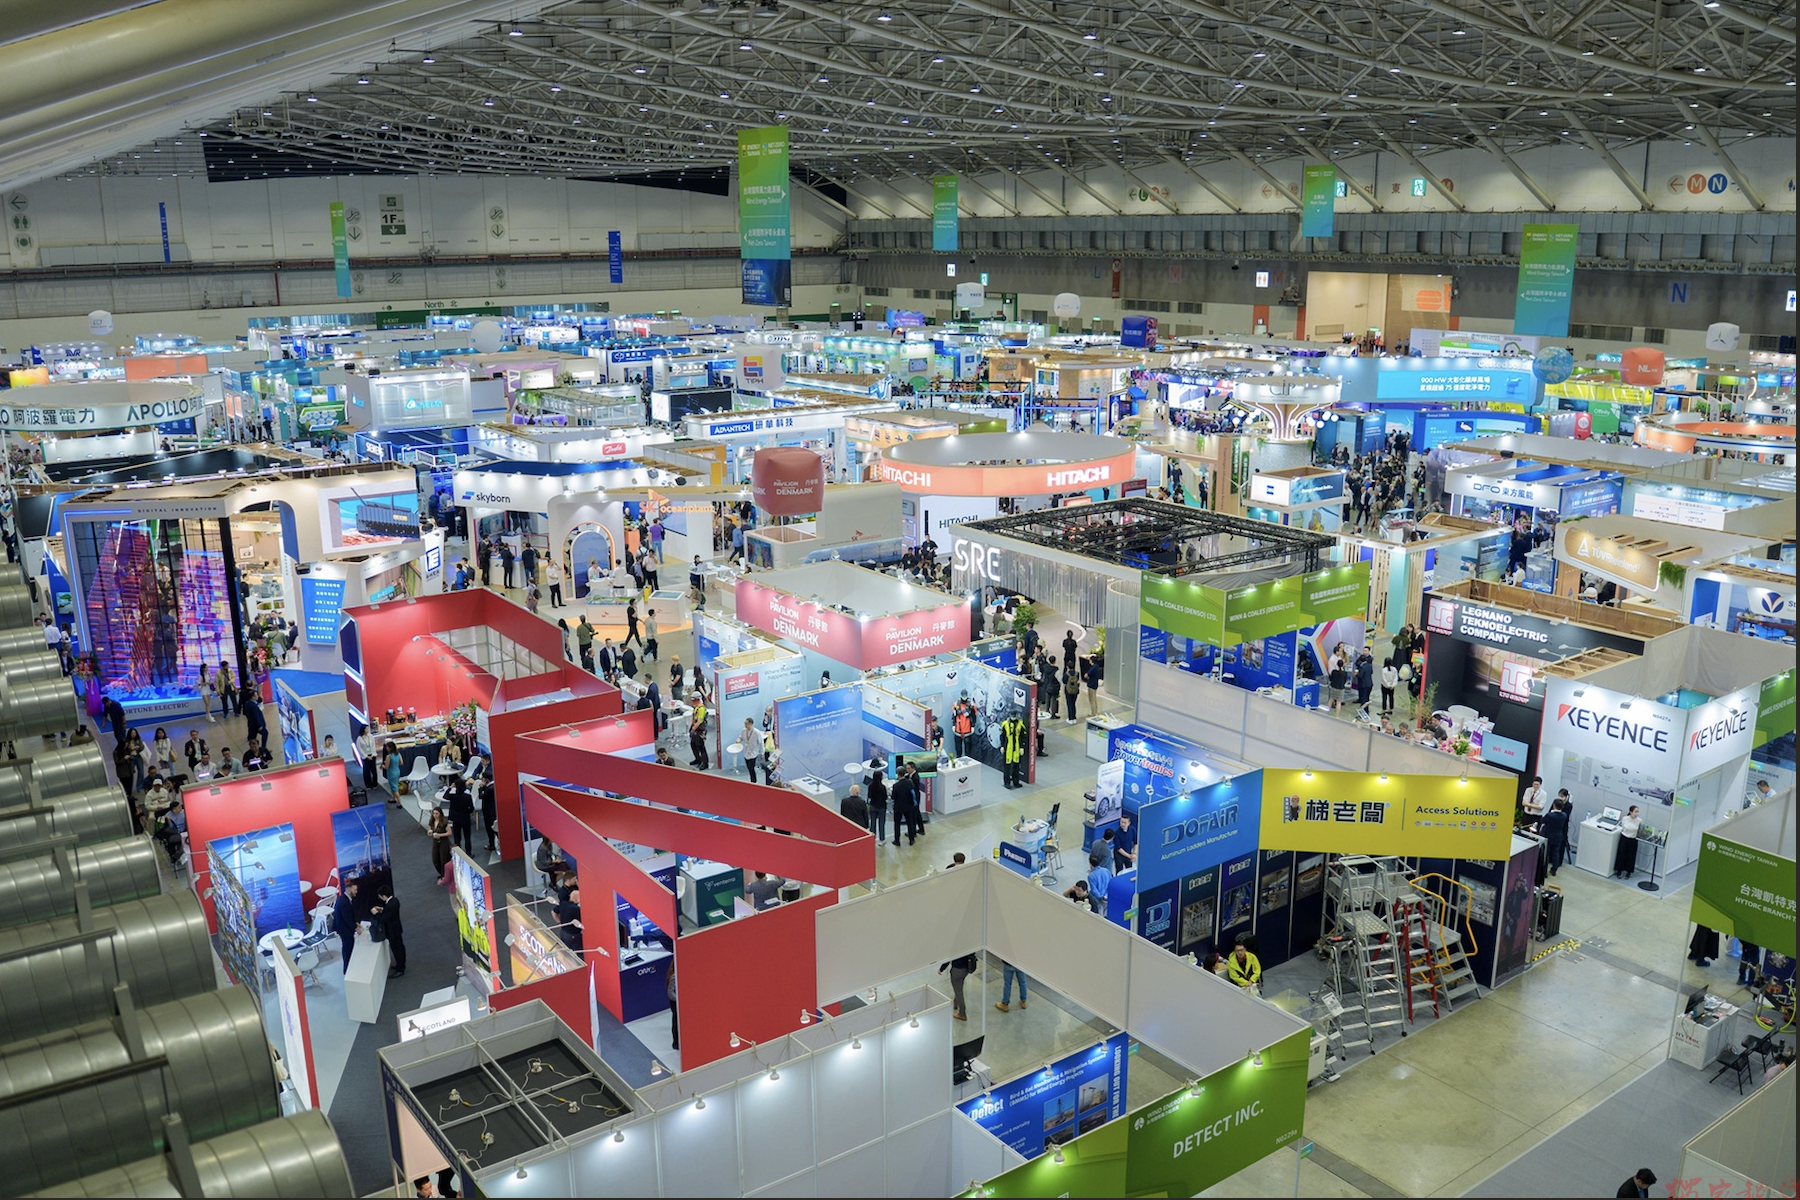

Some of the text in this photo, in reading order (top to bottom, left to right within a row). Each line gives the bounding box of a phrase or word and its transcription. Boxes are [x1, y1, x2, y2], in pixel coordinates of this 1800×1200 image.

[1392, 183, 1401, 194] 東
[1691, 177, 1723, 191] M N
[746, 196, 782, 207] Wind Energy Taiwan
[382, 214, 397, 224] 1F
[763, 239, 777, 247] Taiwan
[1170, 266, 1182, 279] M
[1273, 271, 1284, 284] M
[1672, 282, 1687, 303] N
[127, 399, 189, 422] APOLLO
[419, 400, 443, 409] DELTA
[13, 408, 96, 426] 阿波羅電力
[714, 418, 794, 435] ADVANTECH 研華科技
[882, 463, 931, 487] HITACHI
[1047, 465, 1110, 487] HITACHI
[476, 491, 511, 504] skyborn
[776, 487, 814, 496] DENMARK
[1472, 482, 1534, 500] DFO 東方風能
[639, 501, 714, 515] SK oceanplant
[939, 514, 979, 529] HITACHI
[954, 538, 1001, 582] SRE
[769, 600, 800, 621] PAVILION
[1145, 596, 1161, 606] WINN
[1163, 600, 1184, 612] COALES
[1184, 607, 1207, 620] (DENSO)
[1206, 613, 1219, 622] LTD.
[1229, 614, 1244, 622] WINN
[1247, 607, 1267, 619] COALES
[1266, 604, 1286, 615] (DENSO)
[1285, 601, 1296, 609] LTD.
[1461, 605, 1512, 624] LEGNANO
[773, 618, 820, 648] DENMARK
[807, 615, 829, 633] 丹麥館
[932, 620, 956, 633] 丹麥館
[1461, 615, 1549, 644] TEKNOELECTRIC
[885, 626, 922, 641] PAVILION
[1459, 625, 1511, 645] COMPANY
[889, 634, 945, 656] DENMARK
[730, 682, 756, 691] DENMARK
[124, 702, 190, 715] ORTUNE ELECTRIC
[816, 722, 831, 731] MUSE
[1558, 703, 1669, 753] KEYENCE
[1690, 710, 1748, 752] KEYENCE
[1492, 745, 1516, 757] WE ARE
[1114, 748, 1174, 778] Powertronics
[1304, 798, 1386, 824] 梯老闆
[1415, 805, 1500, 817] Access Solutions
[1160, 828, 1239, 861] Aluminum Ladders Manufacturer
[1718, 843, 1778, 868] WIND ENERGY TAIWAN
[713, 876, 736, 888] venterra
[1740, 883, 1796, 913] 台灣凱特克
[1735, 896, 1792, 921] HYTORC BRANCH
[422, 1017, 457, 1032] SCOTLAND
[1009, 1093, 1019, 1101] Bird
[1033, 1075, 1060, 1092] Monitoring
[1064, 1062, 1088, 1079] Mitigation
[1087, 1052, 1107, 1068] Systems
[1112, 1045, 1122, 1119] LOOKING OUT FOR THE
[1009, 1093, 1030, 1108] (BMMS)
[1036, 1083, 1048, 1095] Wind
[1048, 1078, 1066, 1092] Energy
[1065, 1069, 1084, 1083] Projects
[1146, 1095, 1185, 1119] WIND ENERGY
[1173, 1100, 1265, 1159] DETECT INC.
[1276, 1129, 1298, 1145] N0229a
